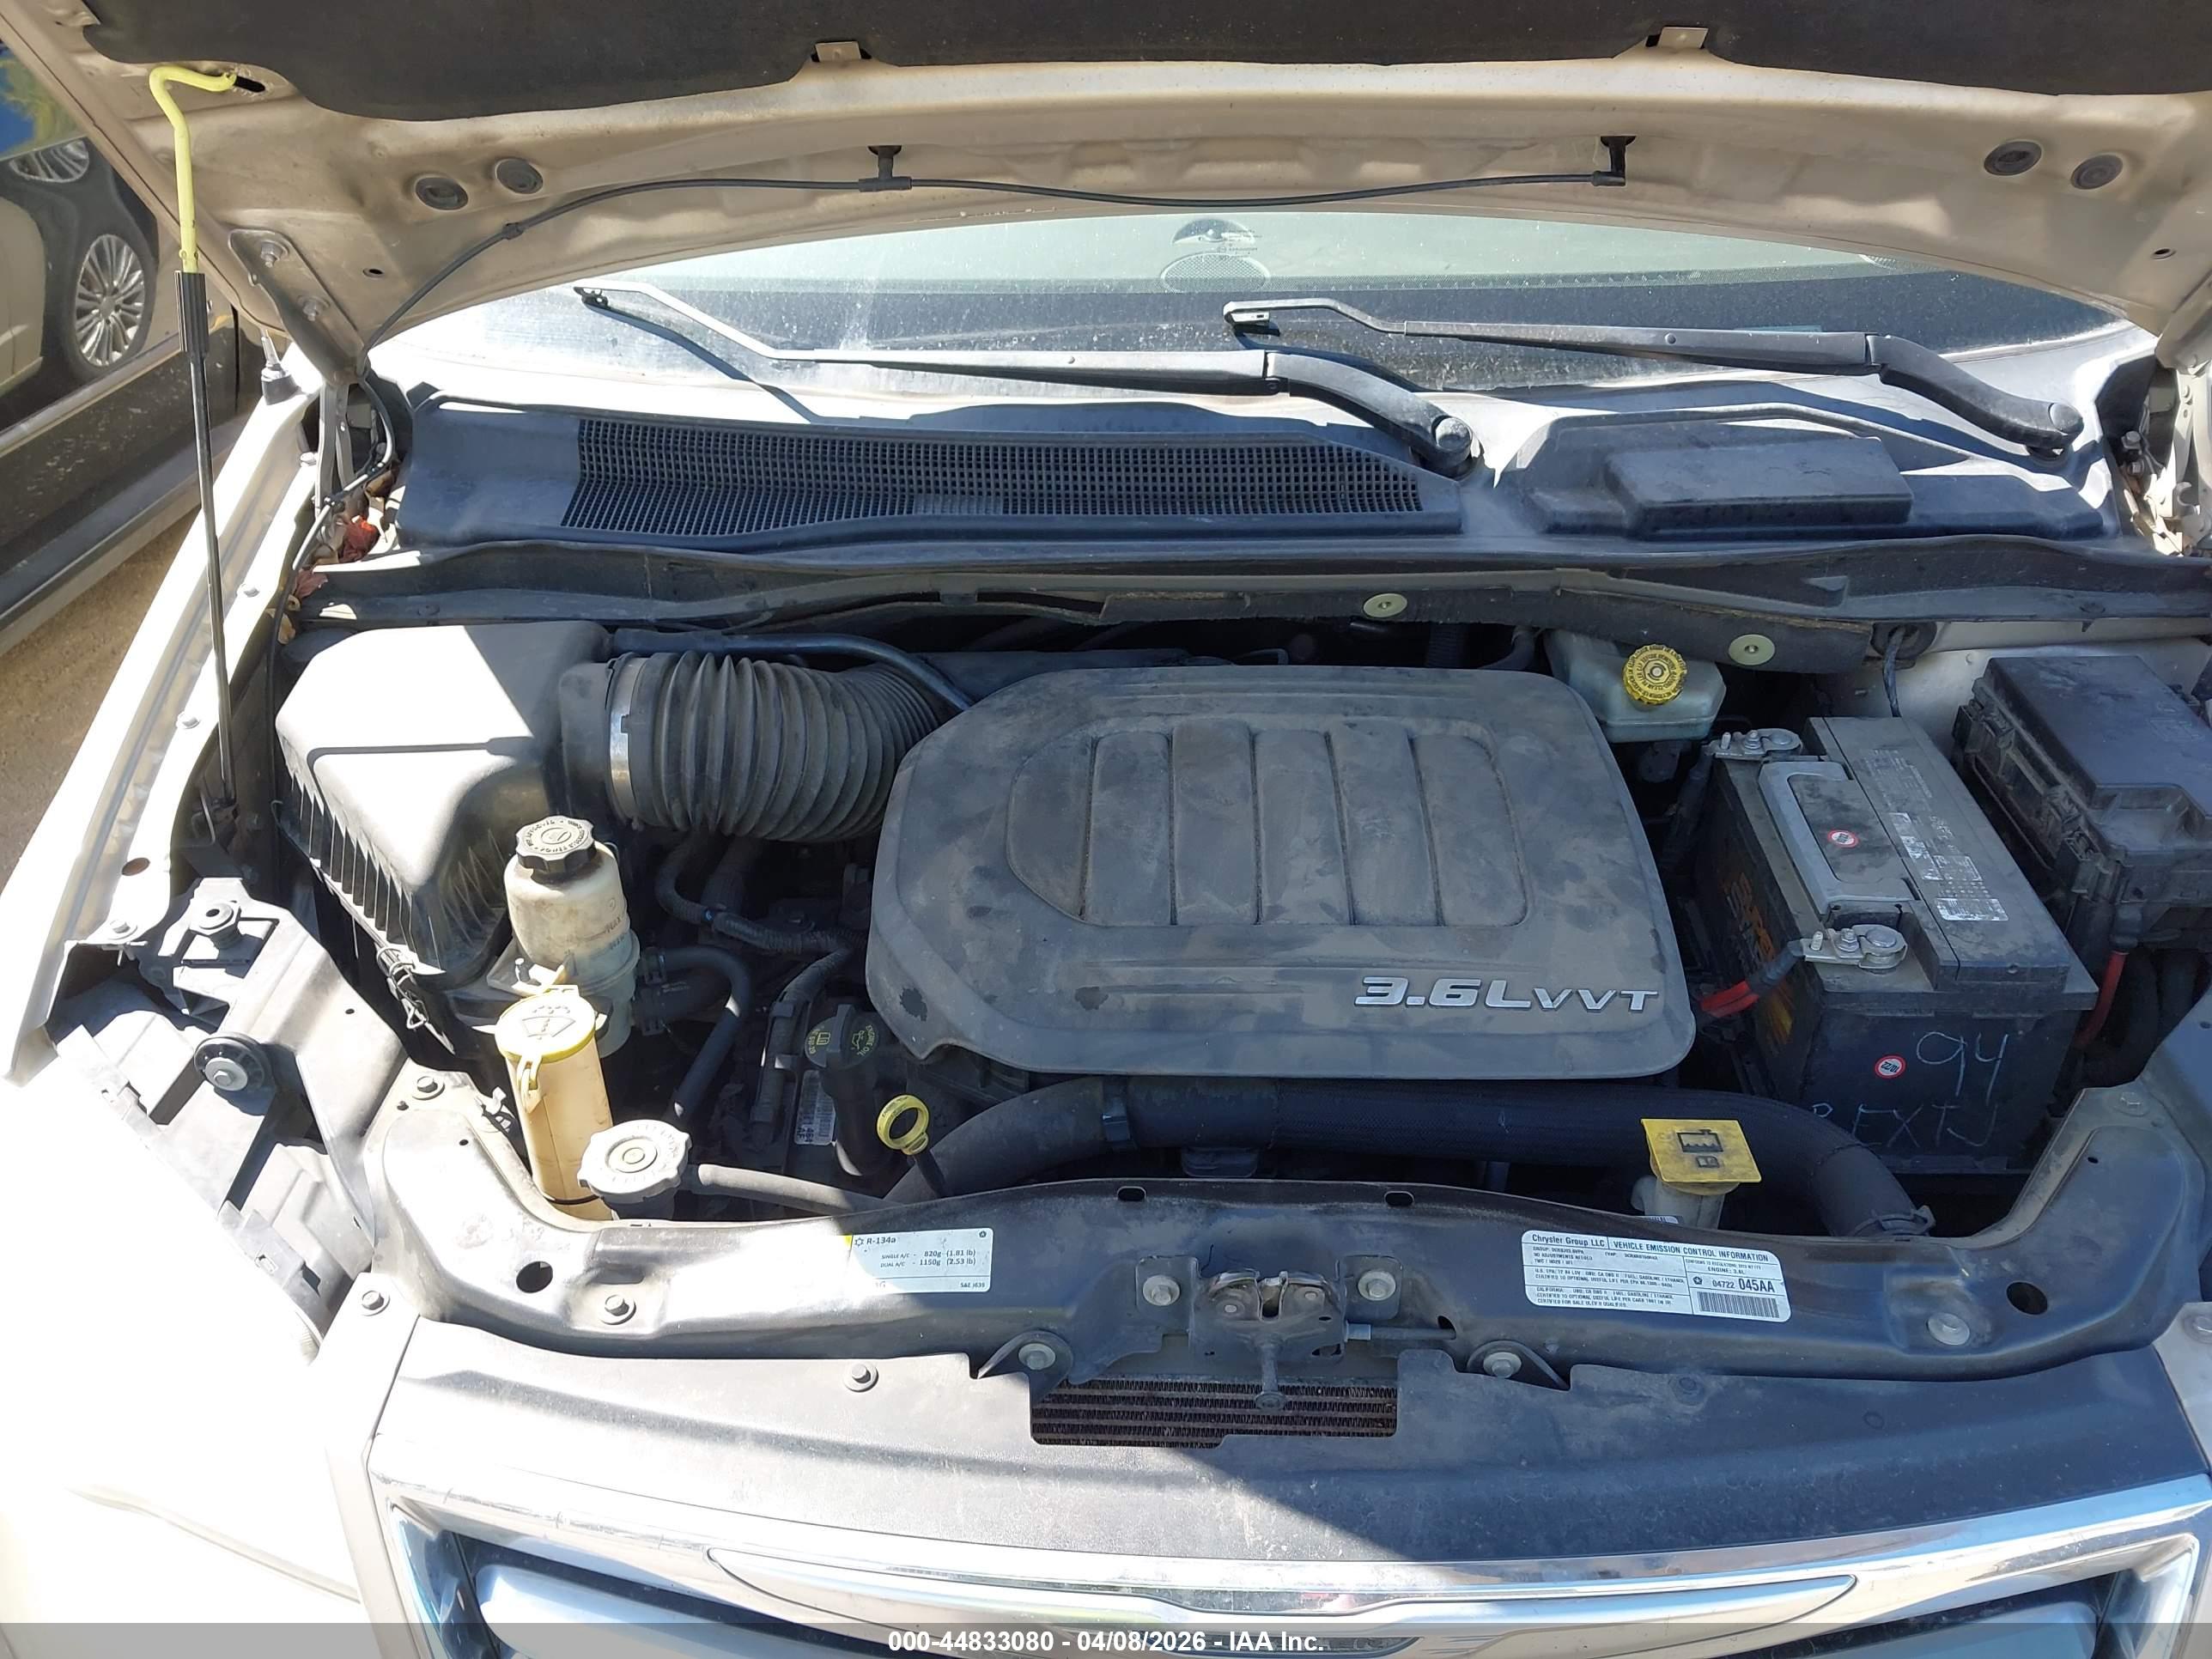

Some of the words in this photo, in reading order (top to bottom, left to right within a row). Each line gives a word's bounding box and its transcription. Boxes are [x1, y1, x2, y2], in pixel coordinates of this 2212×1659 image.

[1354, 975, 1531, 1009] 3.6L
[1532, 987, 1658, 1012] VVT
[856, 1046, 870, 1056] OIL
[1532, 1234, 1563, 1244] Chrysler
[1565, 1237, 1589, 1247] Group
[1590, 1239, 1605, 1248] LLC
[967, 1249, 976, 1257] lb)
[1613, 1241, 1644, 1250] VEHICLE
[1645, 1243, 1680, 1254] EMISSION
[1683, 1247, 1717, 1257] CONTROL
[1718, 1250, 1769, 1261] INFORMATION
[946, 1258, 964, 1267] (2.53
[967, 1257, 976, 1266] lb)
[1712, 1279, 1735, 1288] 04722
[1738, 1278, 1776, 1292] 045AA
